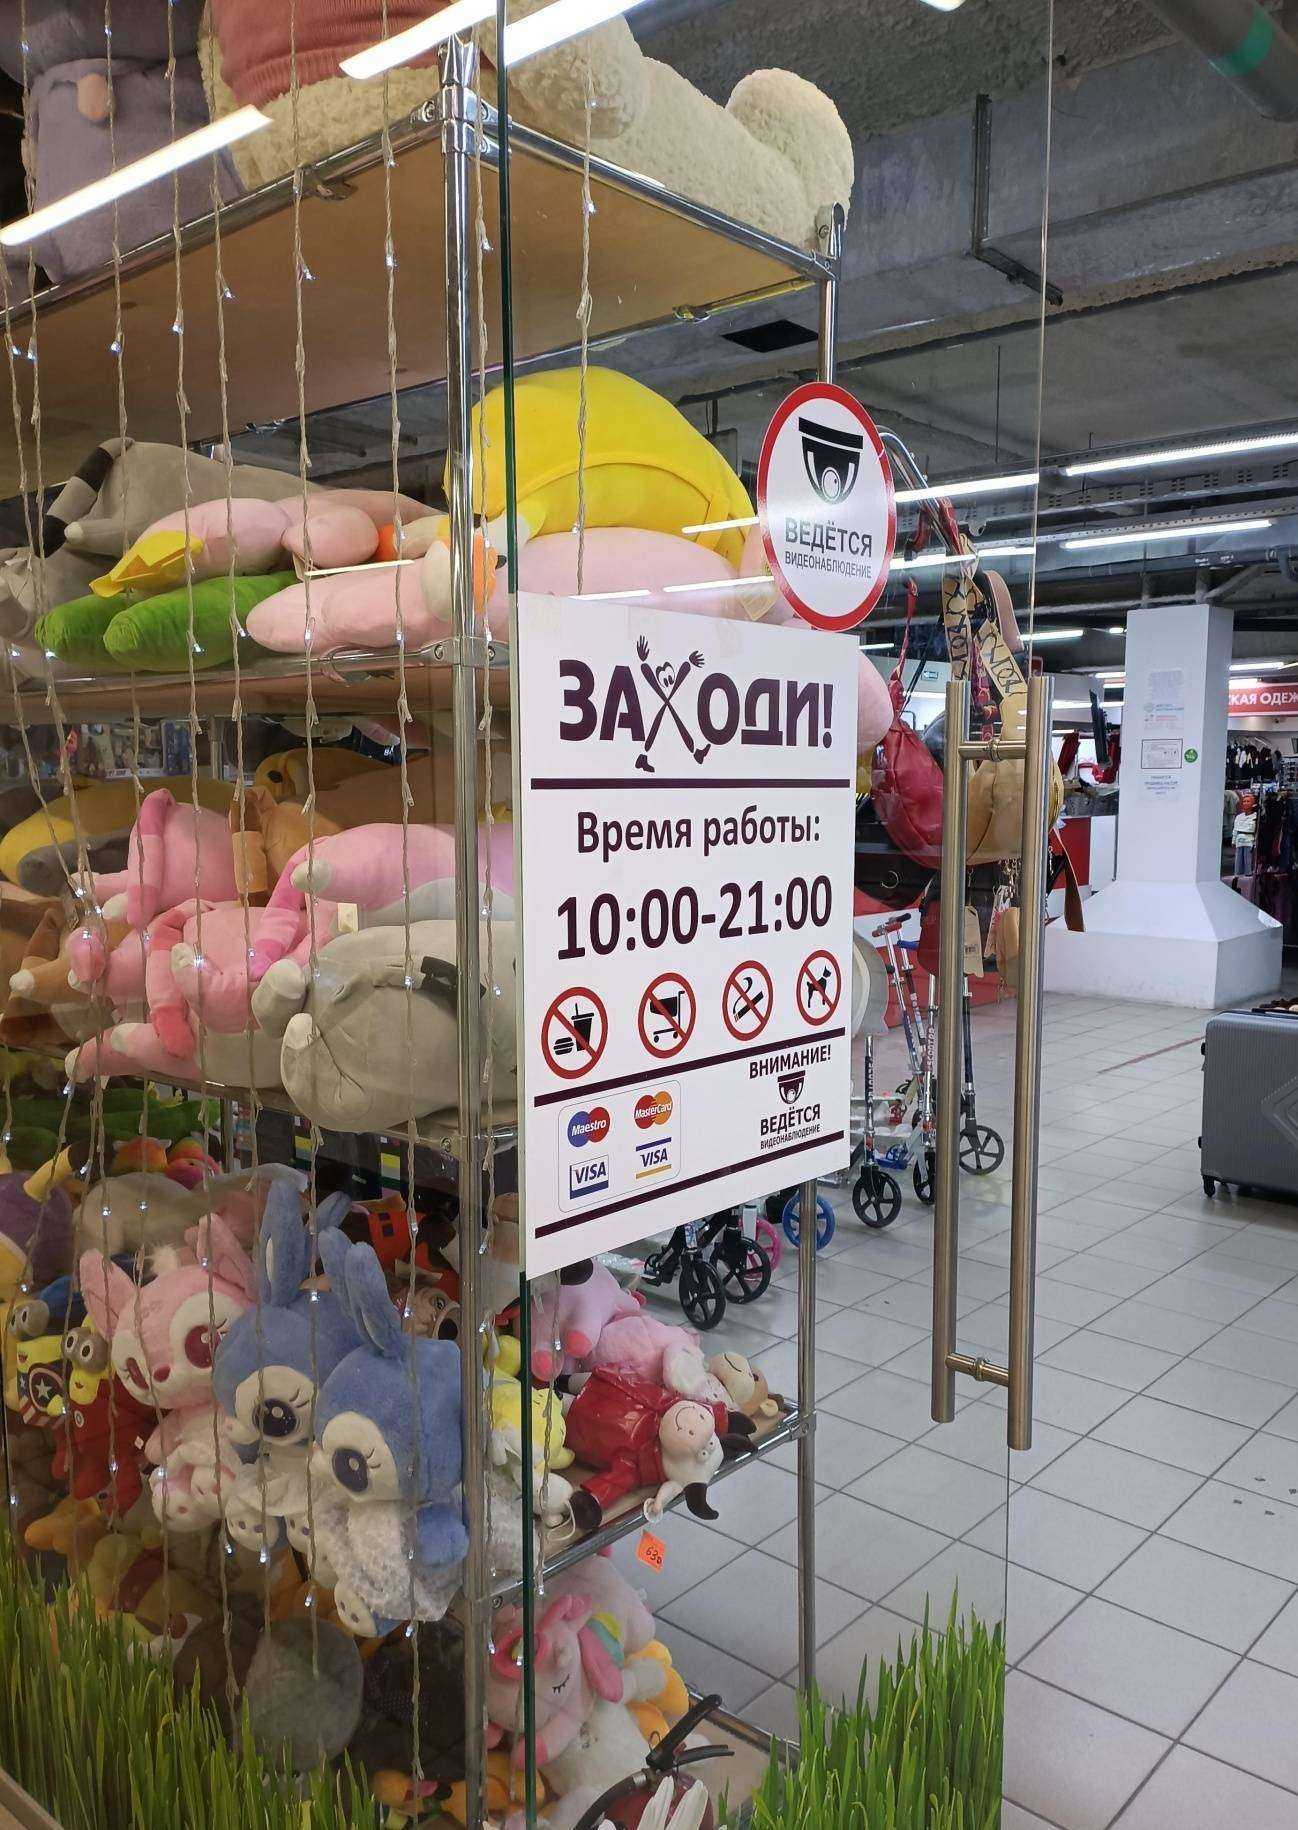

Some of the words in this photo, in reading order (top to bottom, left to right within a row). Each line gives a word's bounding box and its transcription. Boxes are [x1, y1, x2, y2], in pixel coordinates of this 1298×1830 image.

[785, 517, 873, 558] ВЕДЁТСЯ
[784, 551, 872, 579] ВИДЕОНАБЛЮДЕНИЕ
[558, 637, 835, 771] ЗАХОДИ!
[1229, 693, 1258, 706] КАЯ
[577, 811, 692, 863] Время
[703, 804, 821, 857] работы:
[557, 875, 832, 960] 10:00-21:00
[749, 1044, 831, 1079] ВНИМАНИЕ!
[635, 1102, 673, 1118] MasterCard
[760, 1103, 820, 1136] ВЕДЁТСЯ
[571, 1119, 607, 1137] Maestro
[760, 1124, 820, 1150] ВИДЕОНАБЛЮДЕНИЕ
[640, 1148, 668, 1168] VISA
[575, 1161, 607, 1184] VISA
